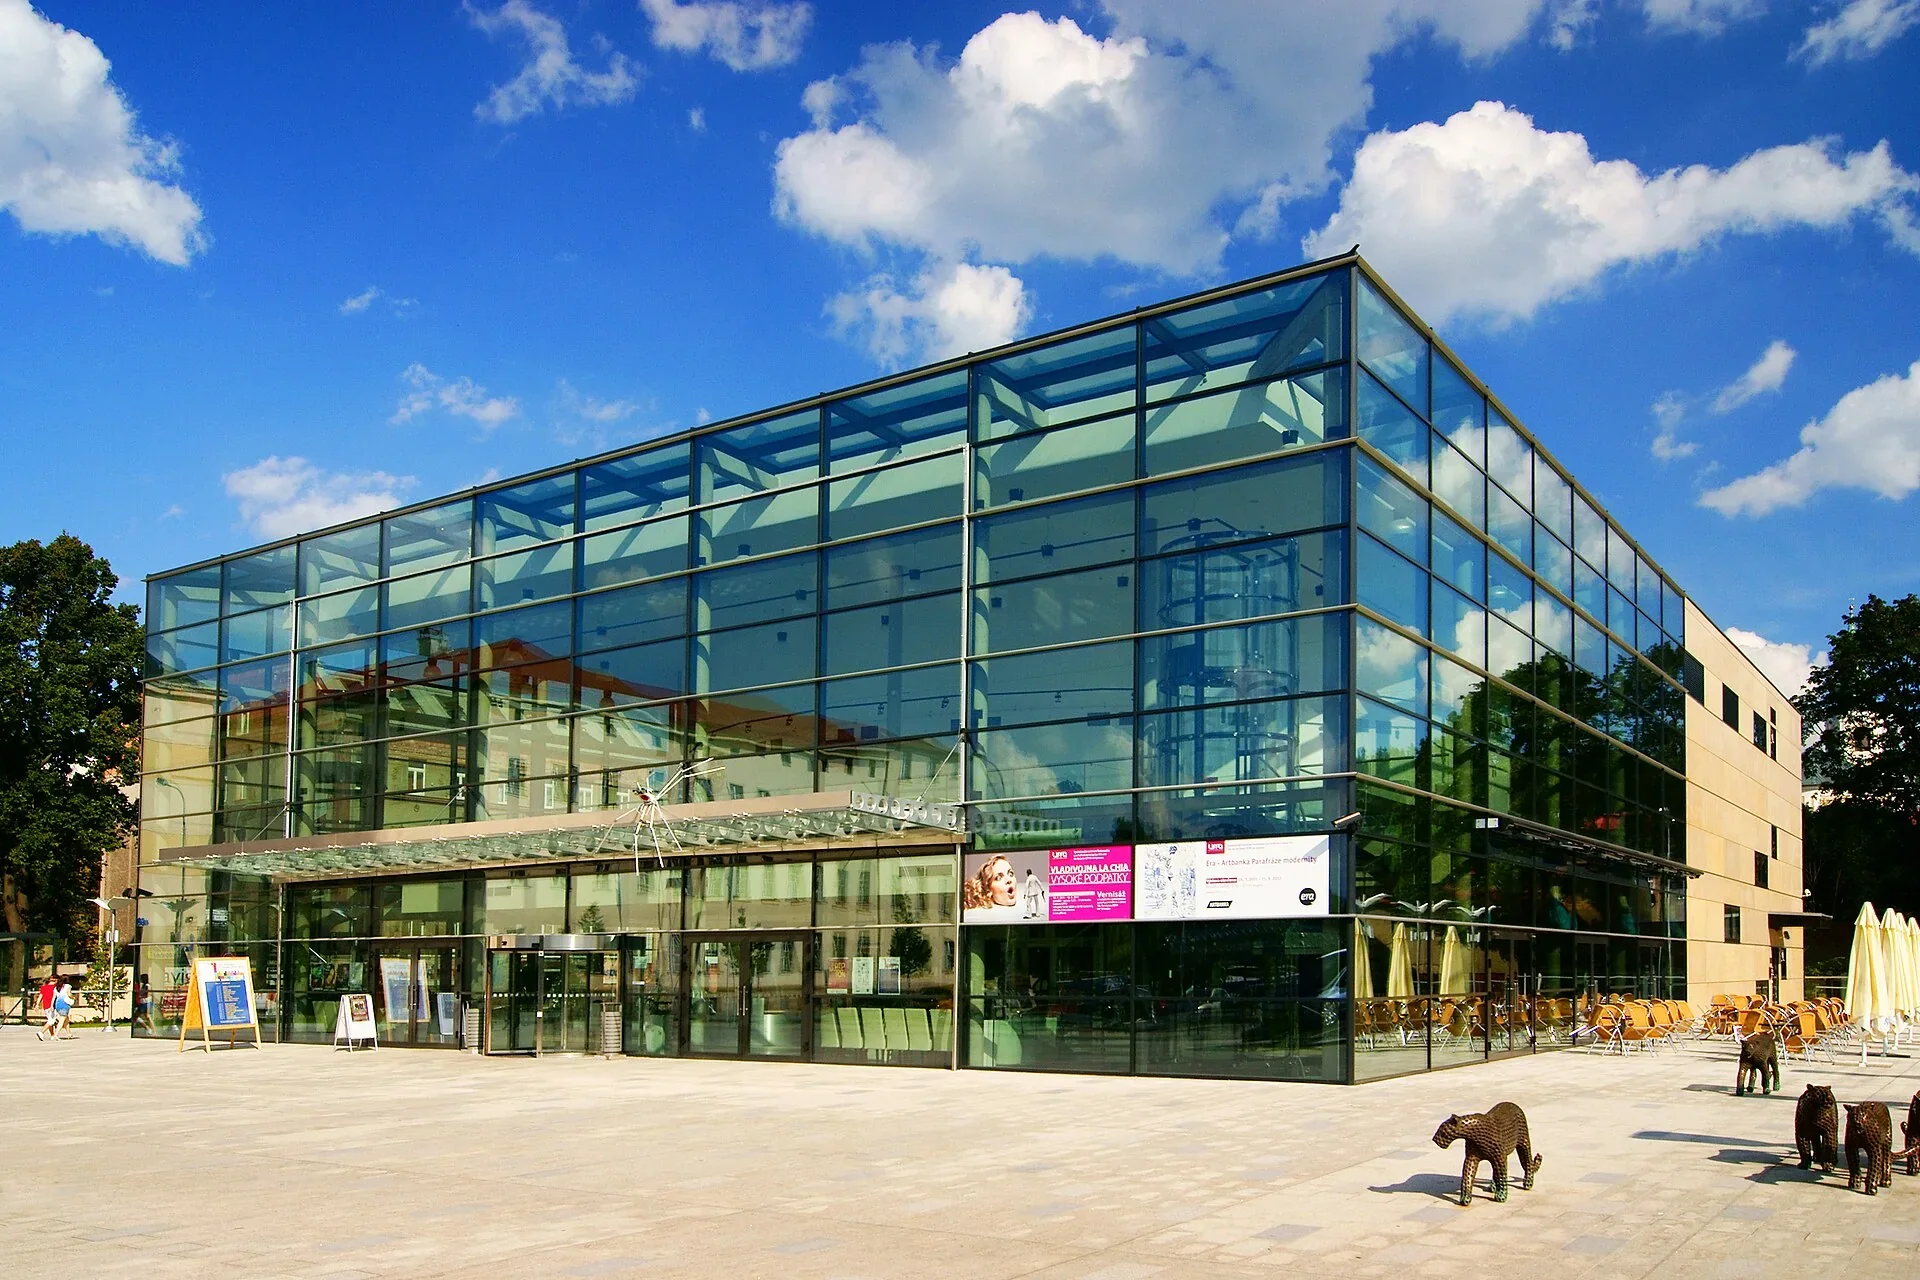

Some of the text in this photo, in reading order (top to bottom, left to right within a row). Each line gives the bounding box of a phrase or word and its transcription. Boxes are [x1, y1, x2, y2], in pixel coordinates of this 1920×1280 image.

[1283, 856, 1317, 864] modernity
[1050, 863, 1129, 874] VLADIVOJNA LA CHIA
[1051, 872, 1128, 884] VYSOKÉ PODPATKY
[1300, 892, 1315, 901] era
